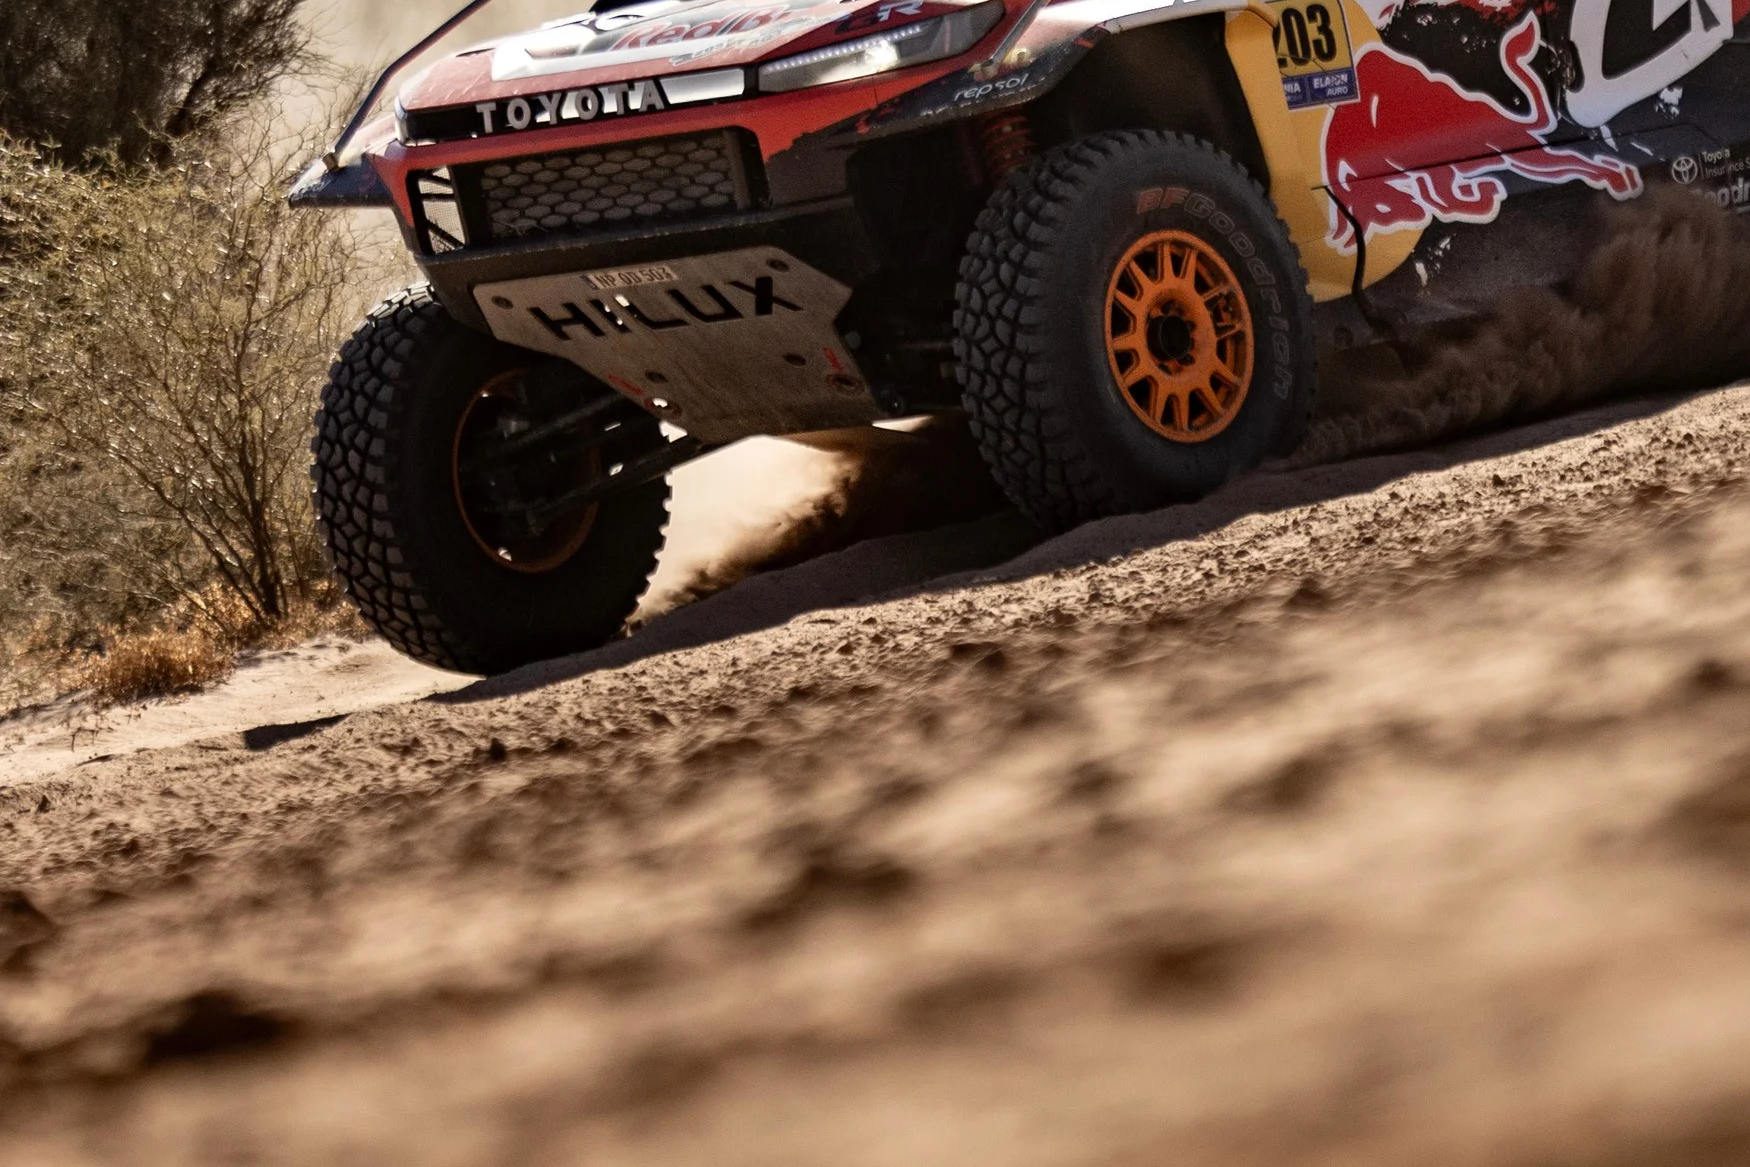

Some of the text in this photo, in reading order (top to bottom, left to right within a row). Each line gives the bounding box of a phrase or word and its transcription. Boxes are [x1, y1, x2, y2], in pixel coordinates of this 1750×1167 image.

[476, 77, 667, 134] TOYOTA
[953, 72, 1030, 102] repsol
[1706, 161, 1744, 178] Insurnce
[528, 277, 801, 340] HILUX
